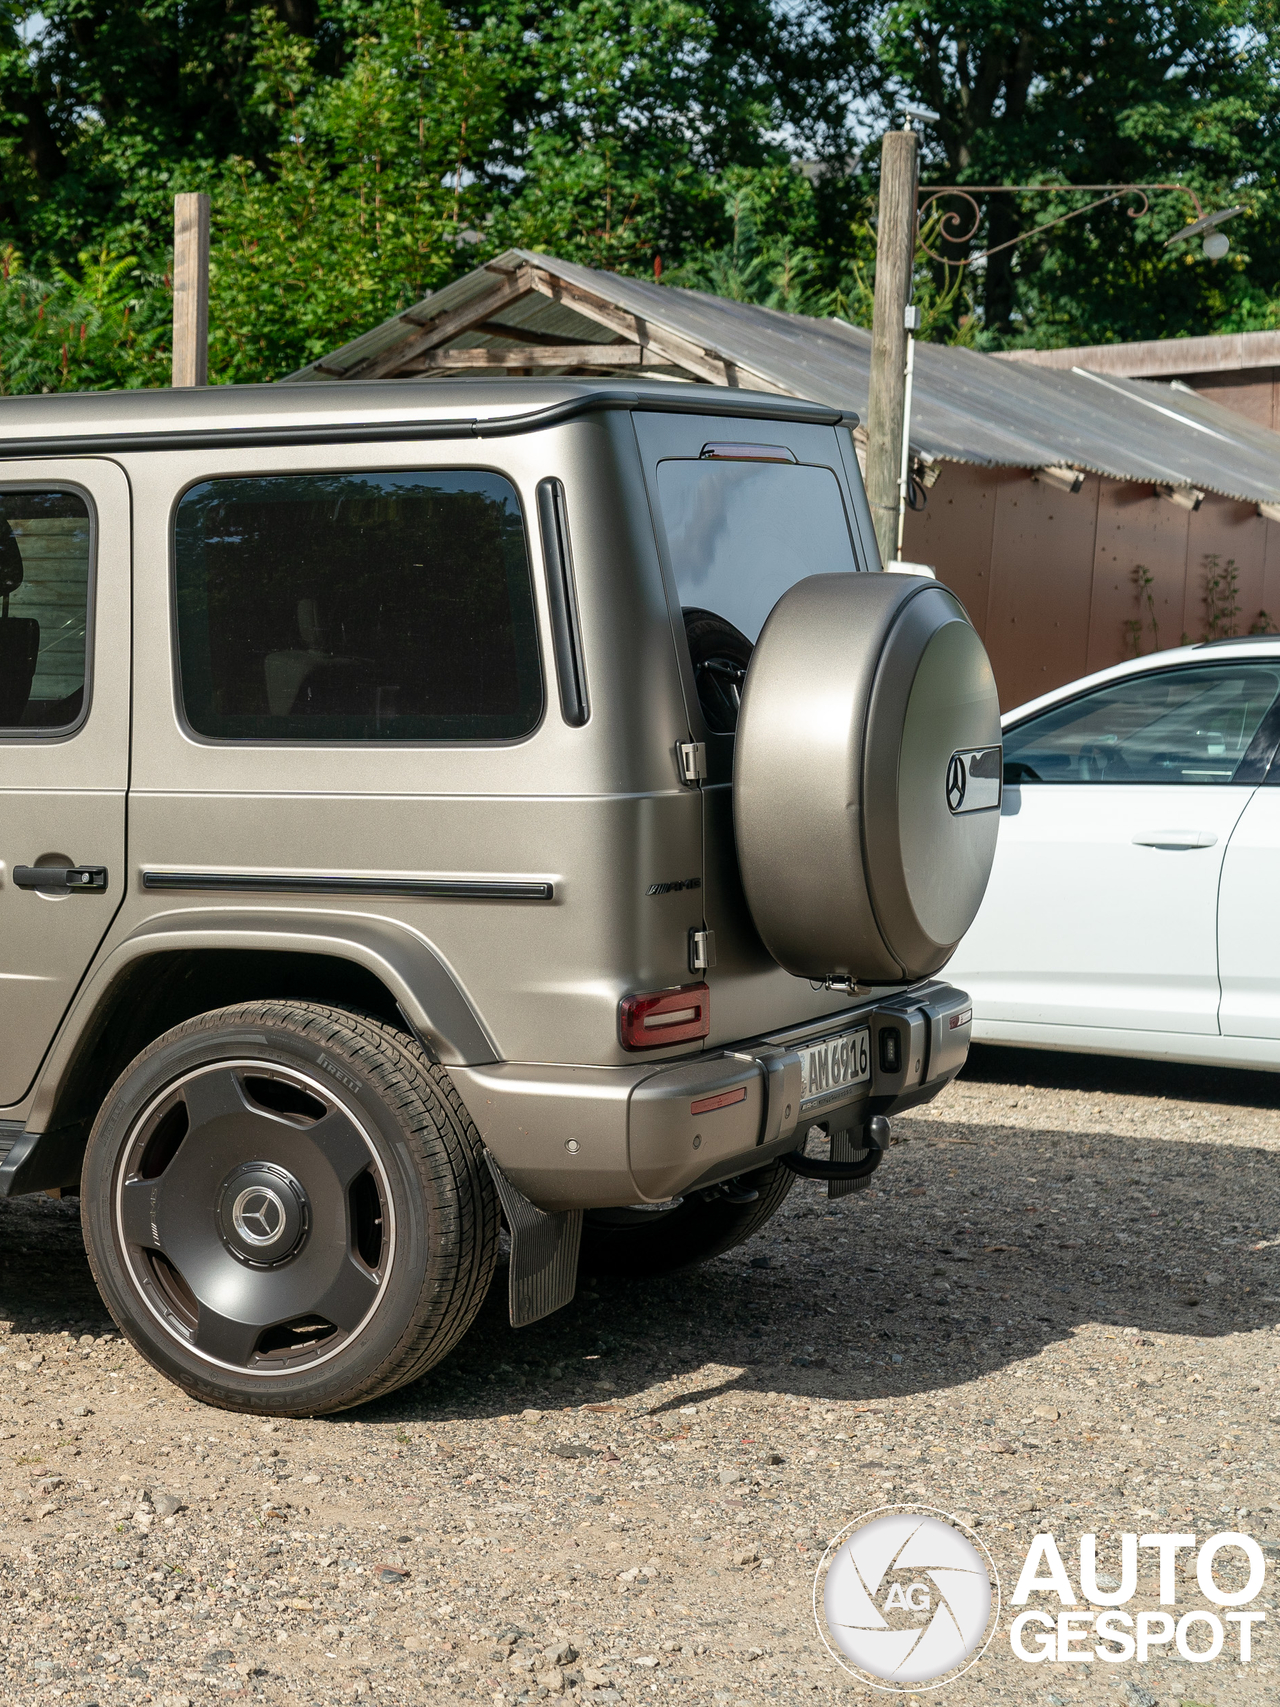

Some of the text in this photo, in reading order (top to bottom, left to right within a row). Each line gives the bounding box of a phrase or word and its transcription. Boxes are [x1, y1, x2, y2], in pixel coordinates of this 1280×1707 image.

[316, 1052, 363, 1094] PIRELLI
[809, 1036, 867, 1093] AM 6916
[177, 1362, 369, 1406] SCORPION ZERO
